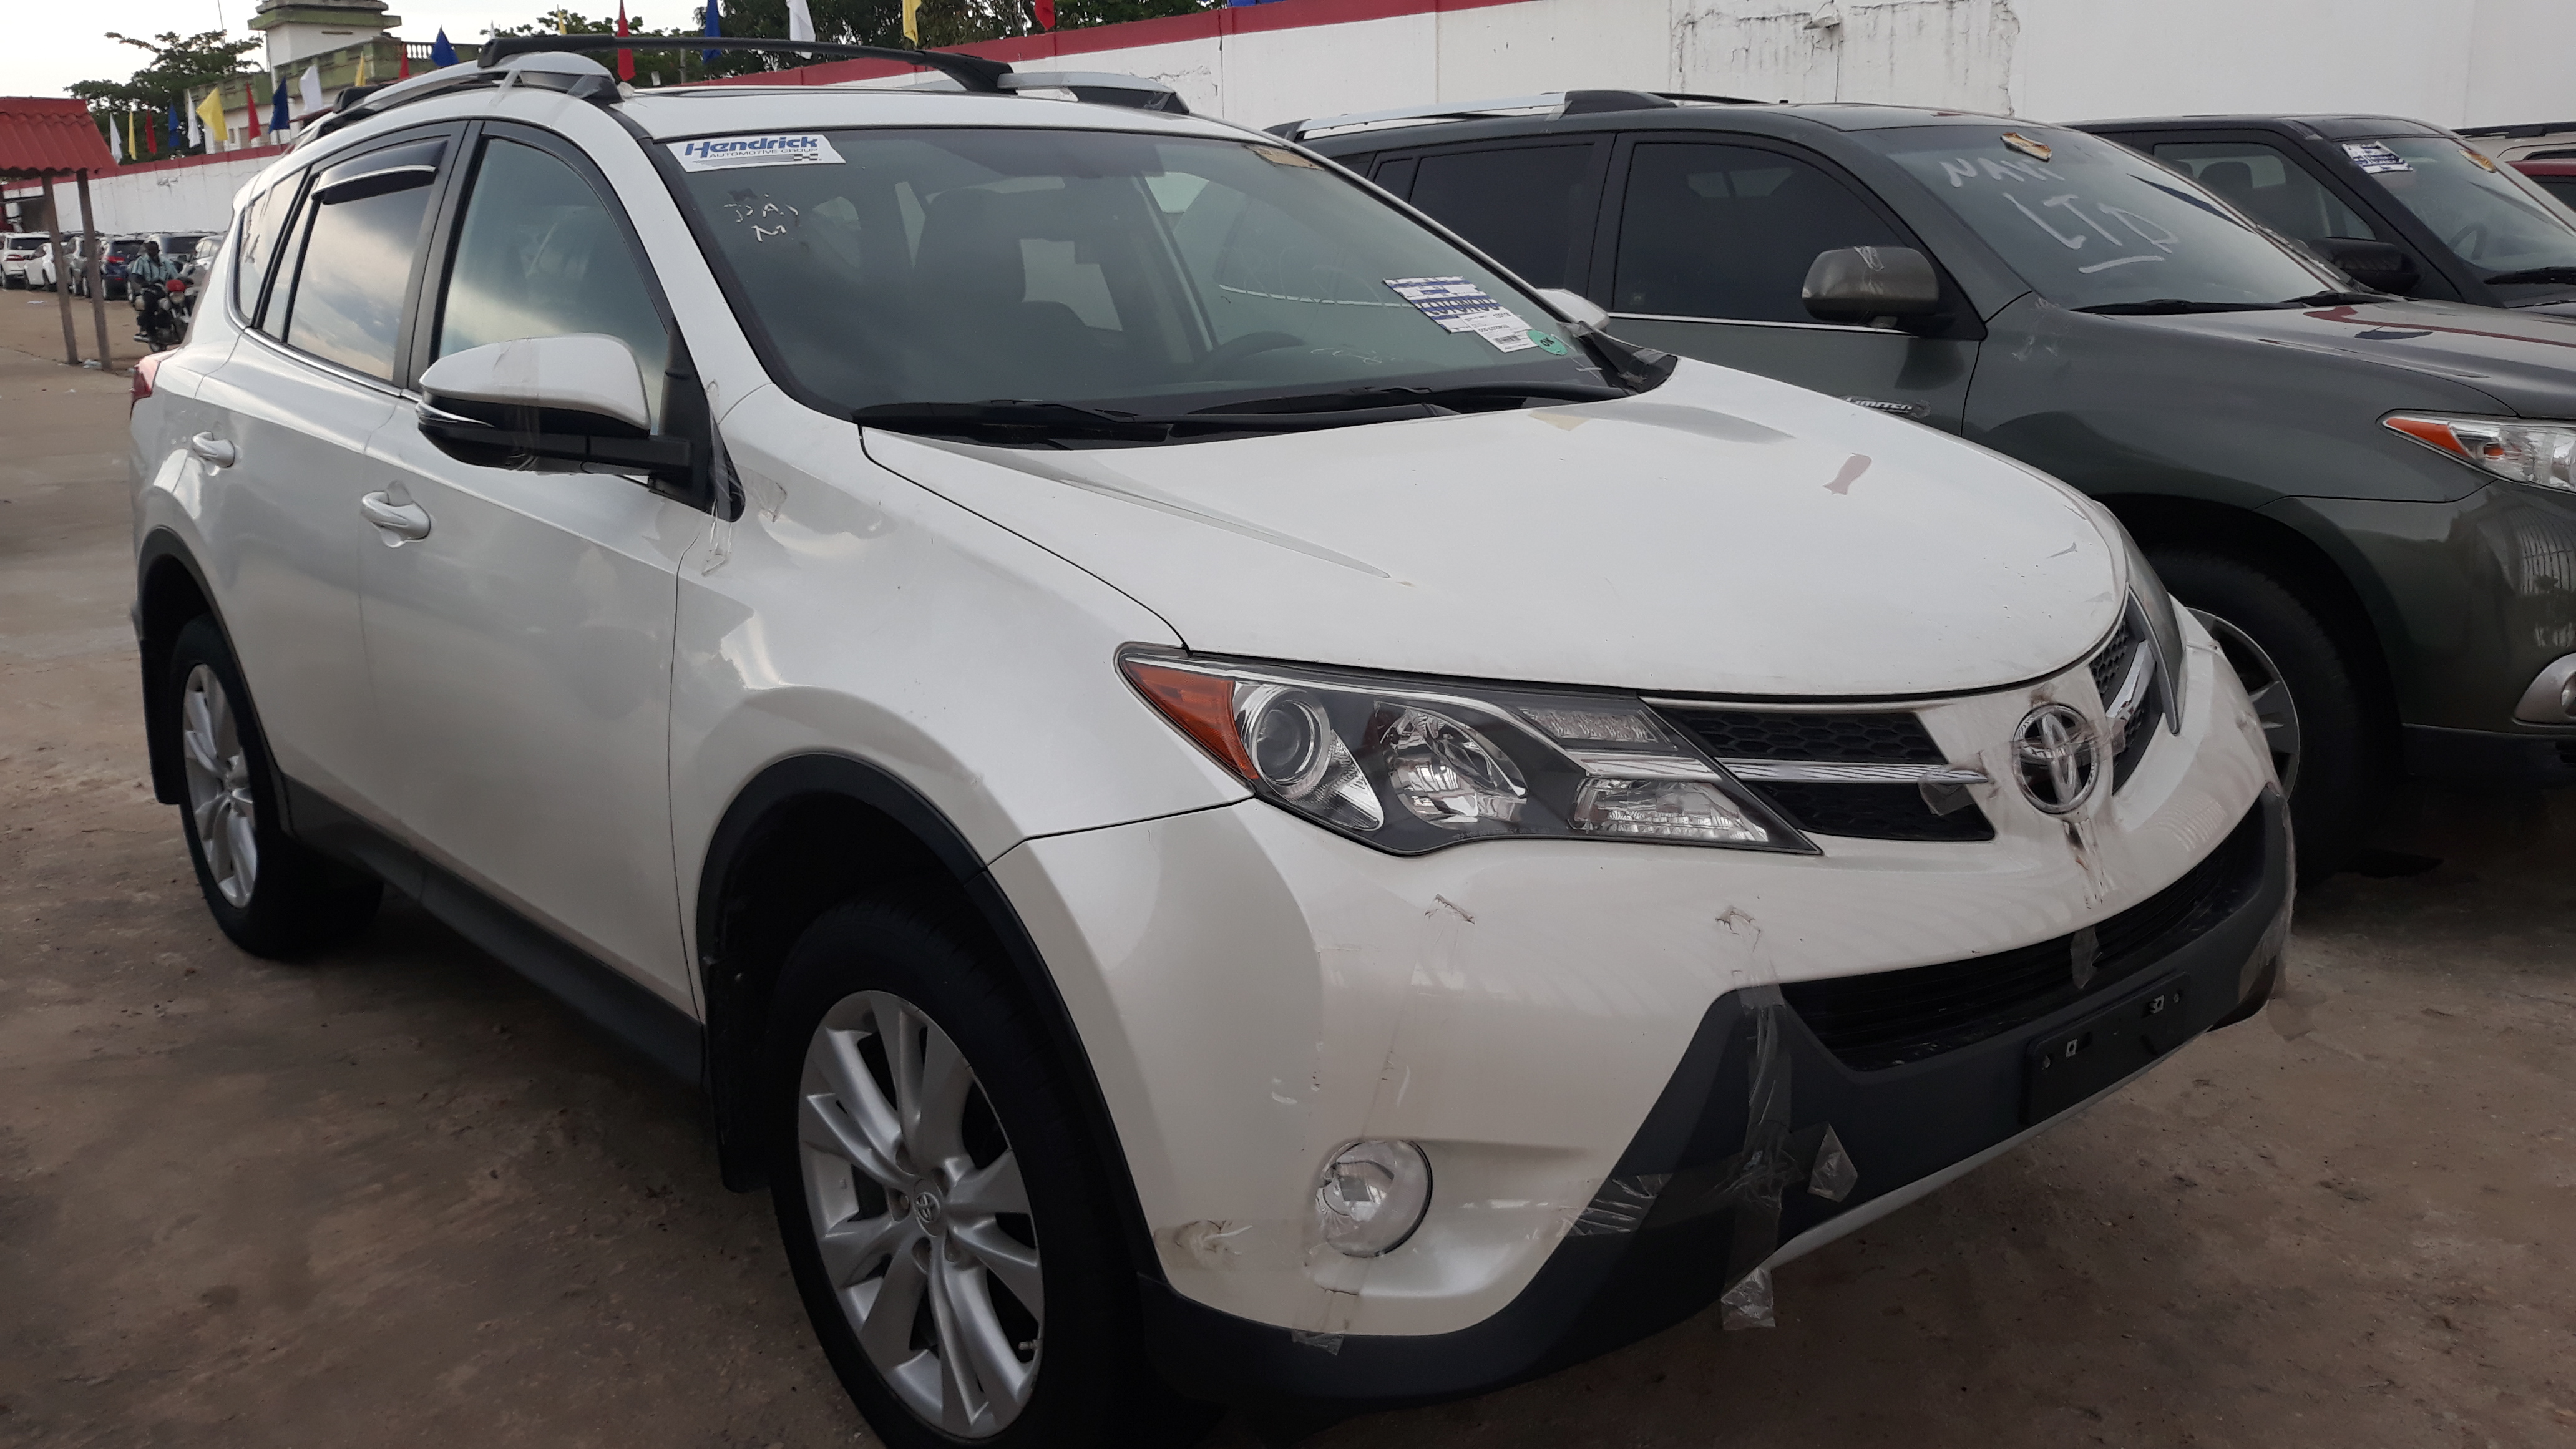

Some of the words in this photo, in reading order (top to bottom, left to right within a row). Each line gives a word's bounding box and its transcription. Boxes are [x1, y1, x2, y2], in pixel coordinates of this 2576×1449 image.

[685, 136, 818, 159] Hendrick
[708, 149, 778, 159] AUTOMOTIVE
[2002, 193, 2180, 254] LTD
[1418, 298, 1500, 315] COTONOU
[1539, 337, 1556, 347] OK
